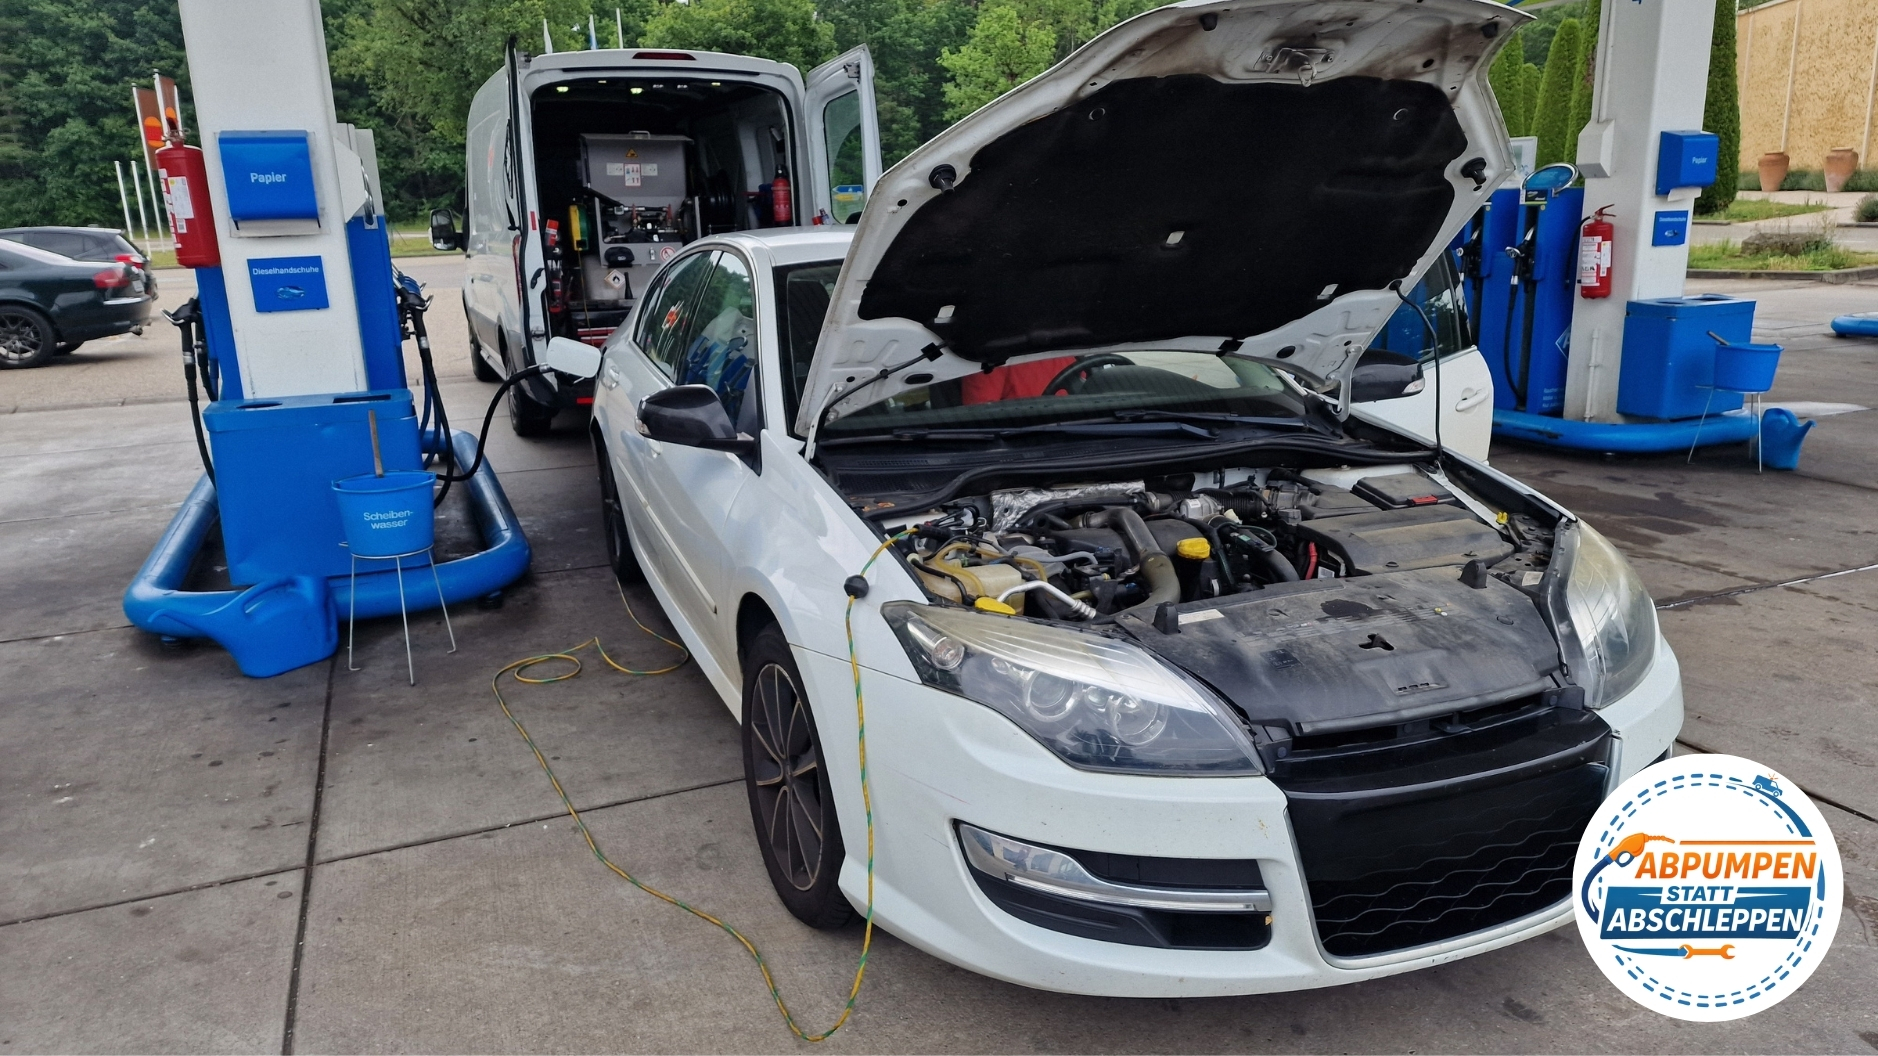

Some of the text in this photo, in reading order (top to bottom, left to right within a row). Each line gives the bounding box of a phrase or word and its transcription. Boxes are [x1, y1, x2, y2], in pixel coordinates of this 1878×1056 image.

[250, 172, 287, 184] Papier
[252, 266, 319, 275] Dieselhandschuhe
[363, 510, 413, 521] Scheiben-
[370, 519, 408, 529] wasser
